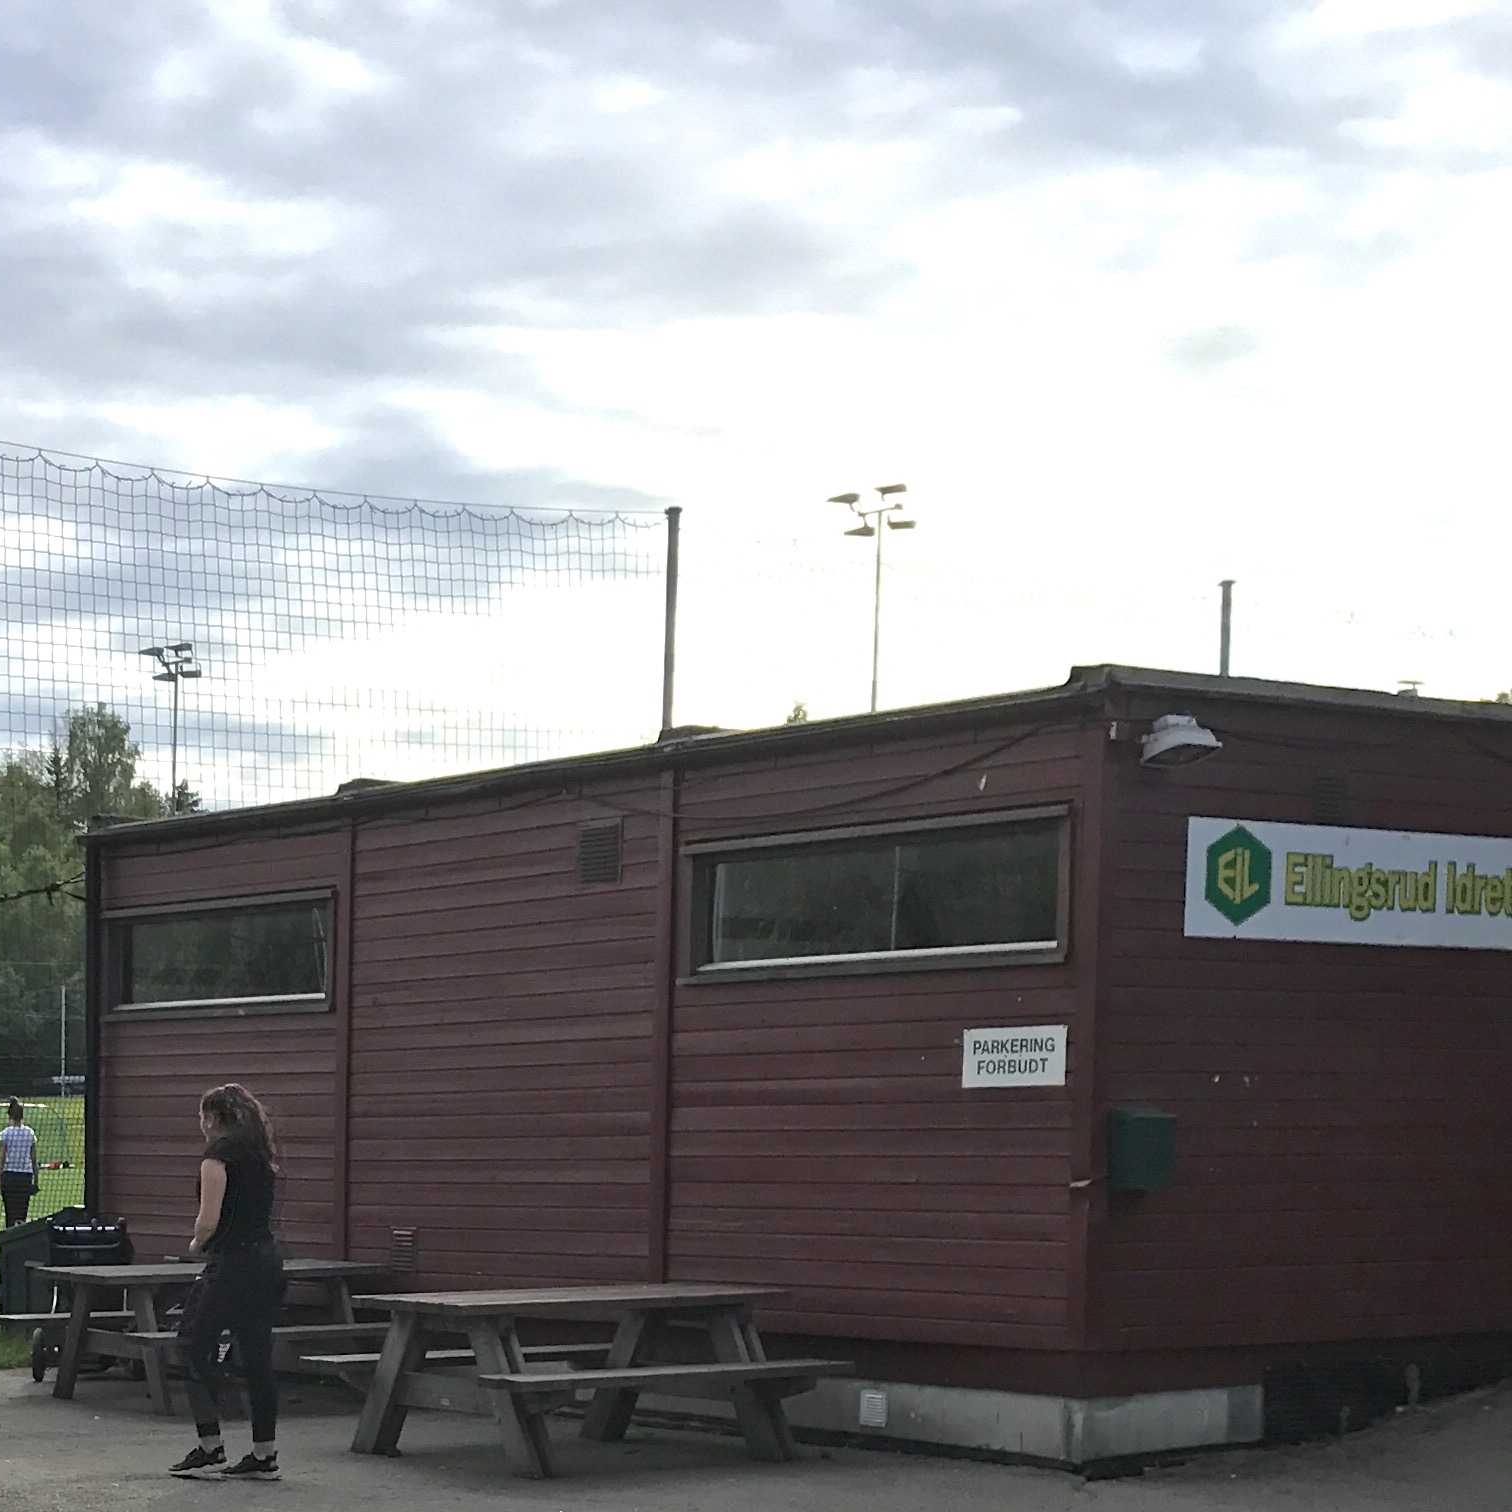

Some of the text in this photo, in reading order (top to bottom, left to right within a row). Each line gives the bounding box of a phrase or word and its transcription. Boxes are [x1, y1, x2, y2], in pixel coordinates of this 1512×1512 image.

[1285, 852, 1437, 921] Ellingsrud
[973, 1037, 1055, 1055] PARKERING
[977, 1058, 1048, 1075] FORBUDT
